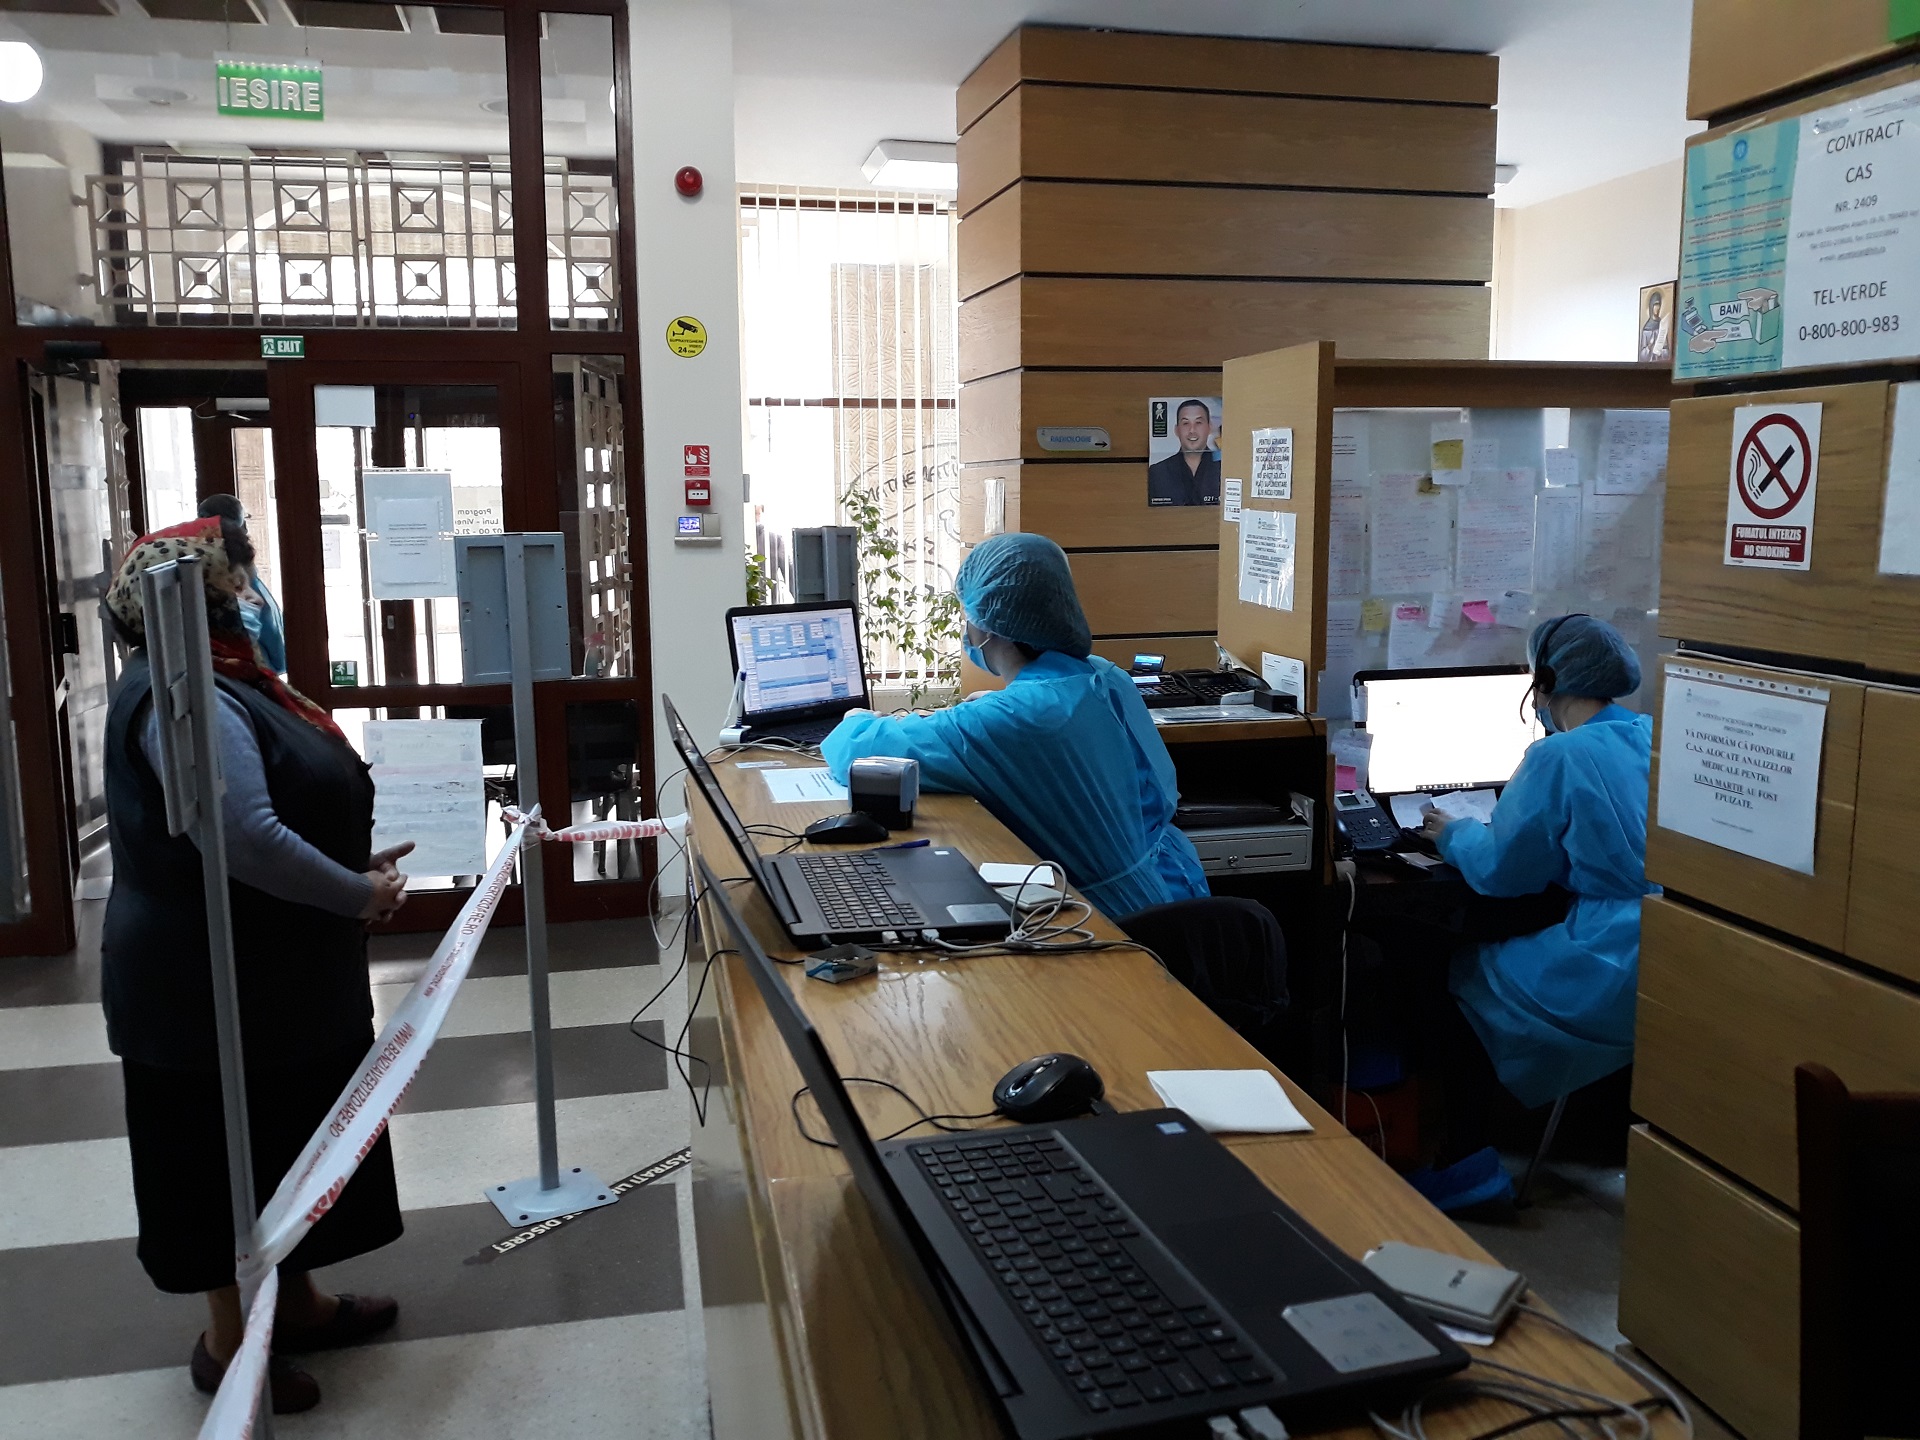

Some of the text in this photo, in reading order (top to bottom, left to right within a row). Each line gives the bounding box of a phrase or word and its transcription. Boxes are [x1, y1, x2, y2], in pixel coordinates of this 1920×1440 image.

[219, 76, 320, 112] IESIRE
[1826, 120, 1904, 154] CONTRACT
[1845, 163, 1873, 183] CAS
[1854, 195, 1878, 210] 2409
[1813, 281, 1887, 306] TEL-VERDE
[1720, 303, 1742, 316] BANI
[1799, 315, 1899, 341] 0-800-800-983
[277, 340, 301, 353] EXIT
[1050, 435, 1092, 443] RADIOLOGIE
[1735, 527, 1802, 541] FUMATUL INTERZIS
[1744, 544, 1790, 558] NO SMOKING
[1706, 748, 1740, 762] ALOCATE
[1742, 756, 1793, 775] ANALIZELOR
[1750, 743, 1795, 761] FONDURILE
[1701, 758, 1770, 784] MEDICALE PENTRU
[1694, 773, 1714, 786] LUNA
[1715, 778, 1743, 793] MARTIE
[1758, 789, 1778, 802] FOST
